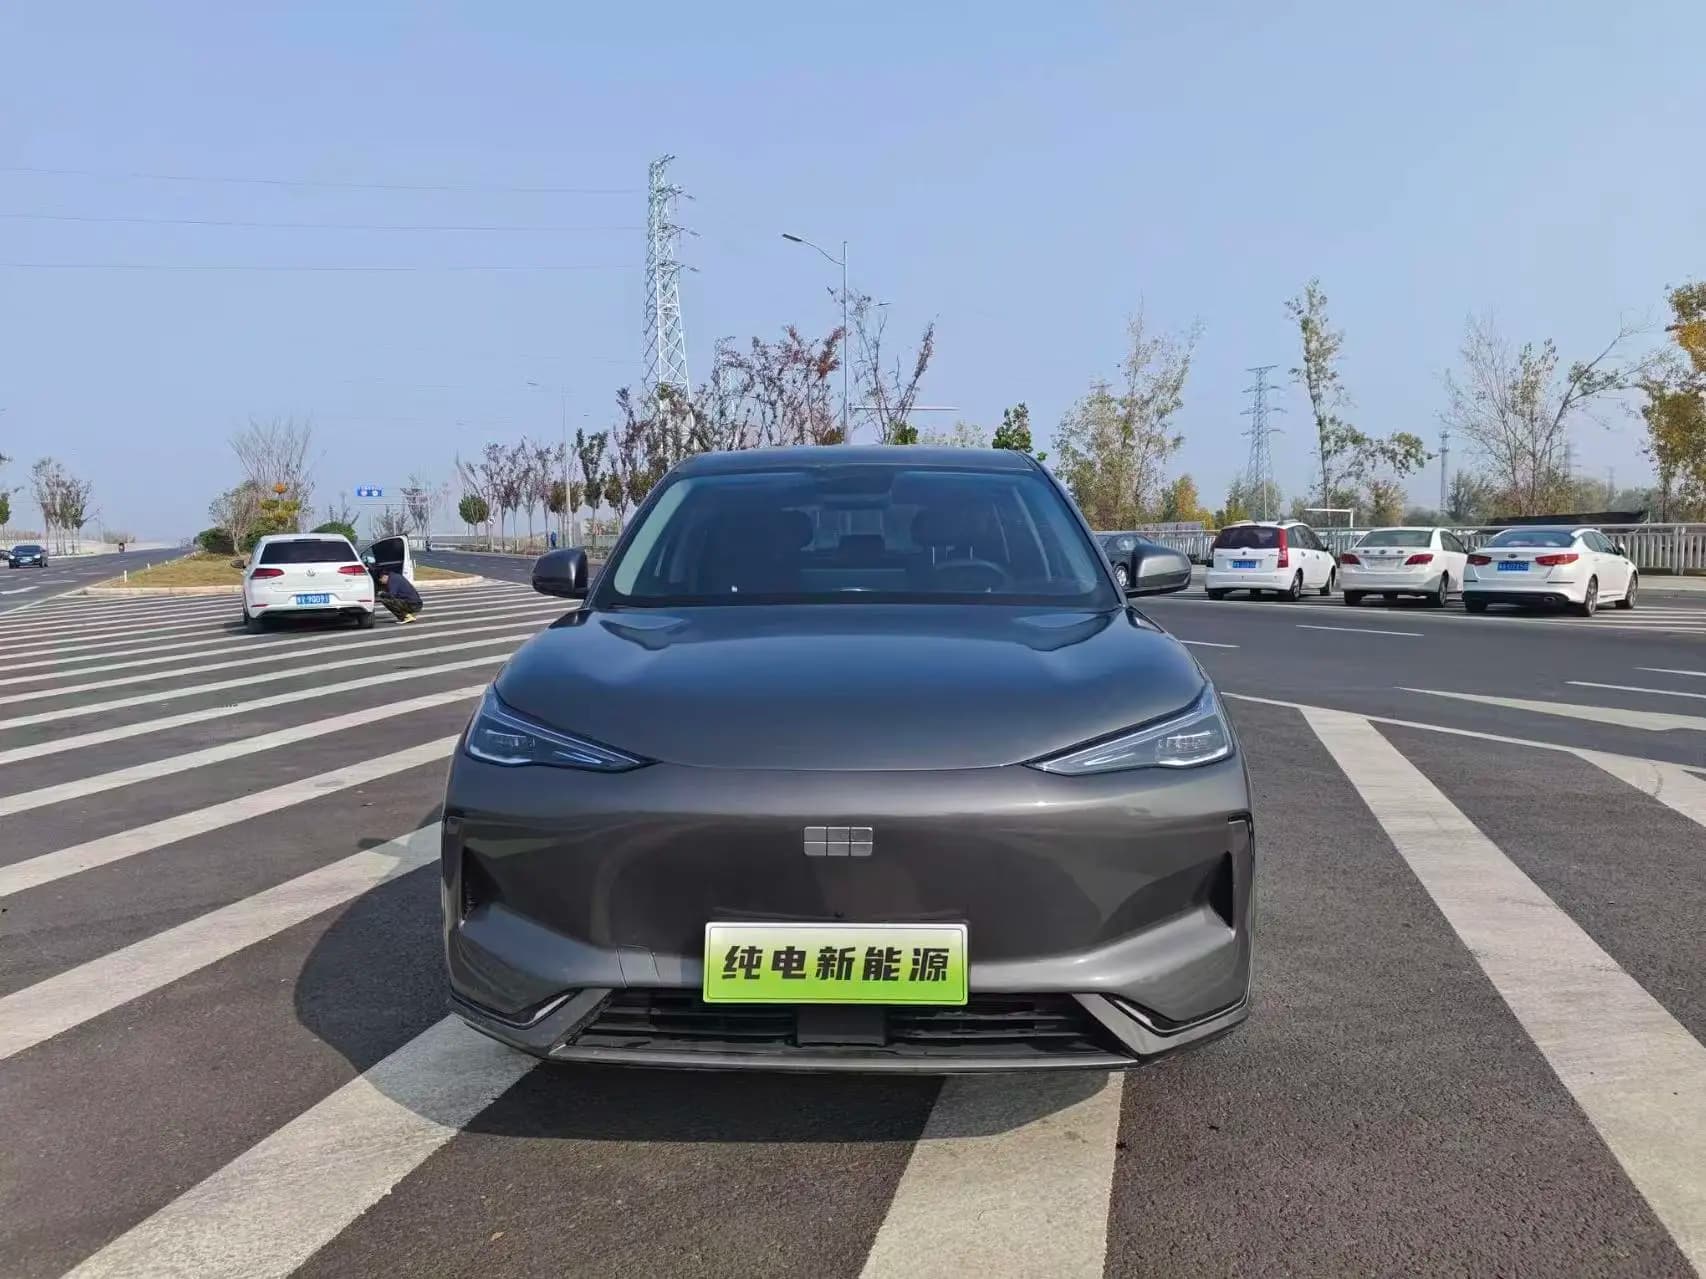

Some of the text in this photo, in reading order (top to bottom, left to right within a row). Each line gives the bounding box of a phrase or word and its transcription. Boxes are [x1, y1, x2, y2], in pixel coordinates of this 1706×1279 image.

[721, 945, 950, 982] 纯电新能源
